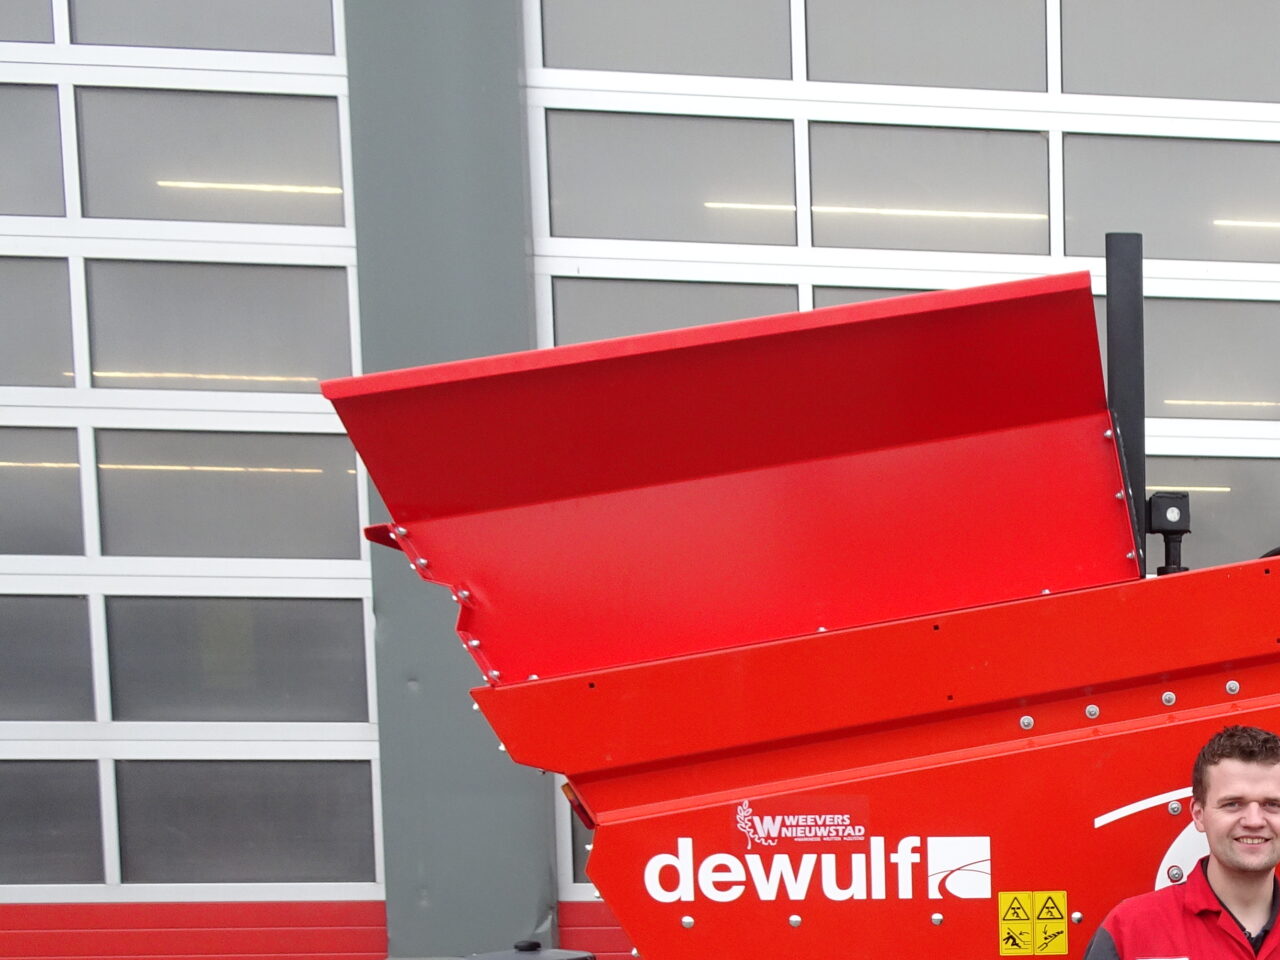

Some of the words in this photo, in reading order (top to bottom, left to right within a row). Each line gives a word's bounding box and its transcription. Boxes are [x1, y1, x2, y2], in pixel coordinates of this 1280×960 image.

[784, 814, 851, 826] WEEVERS
[781, 825, 866, 838] NIEUWSTAD
[643, 836, 921, 904] dewulf
